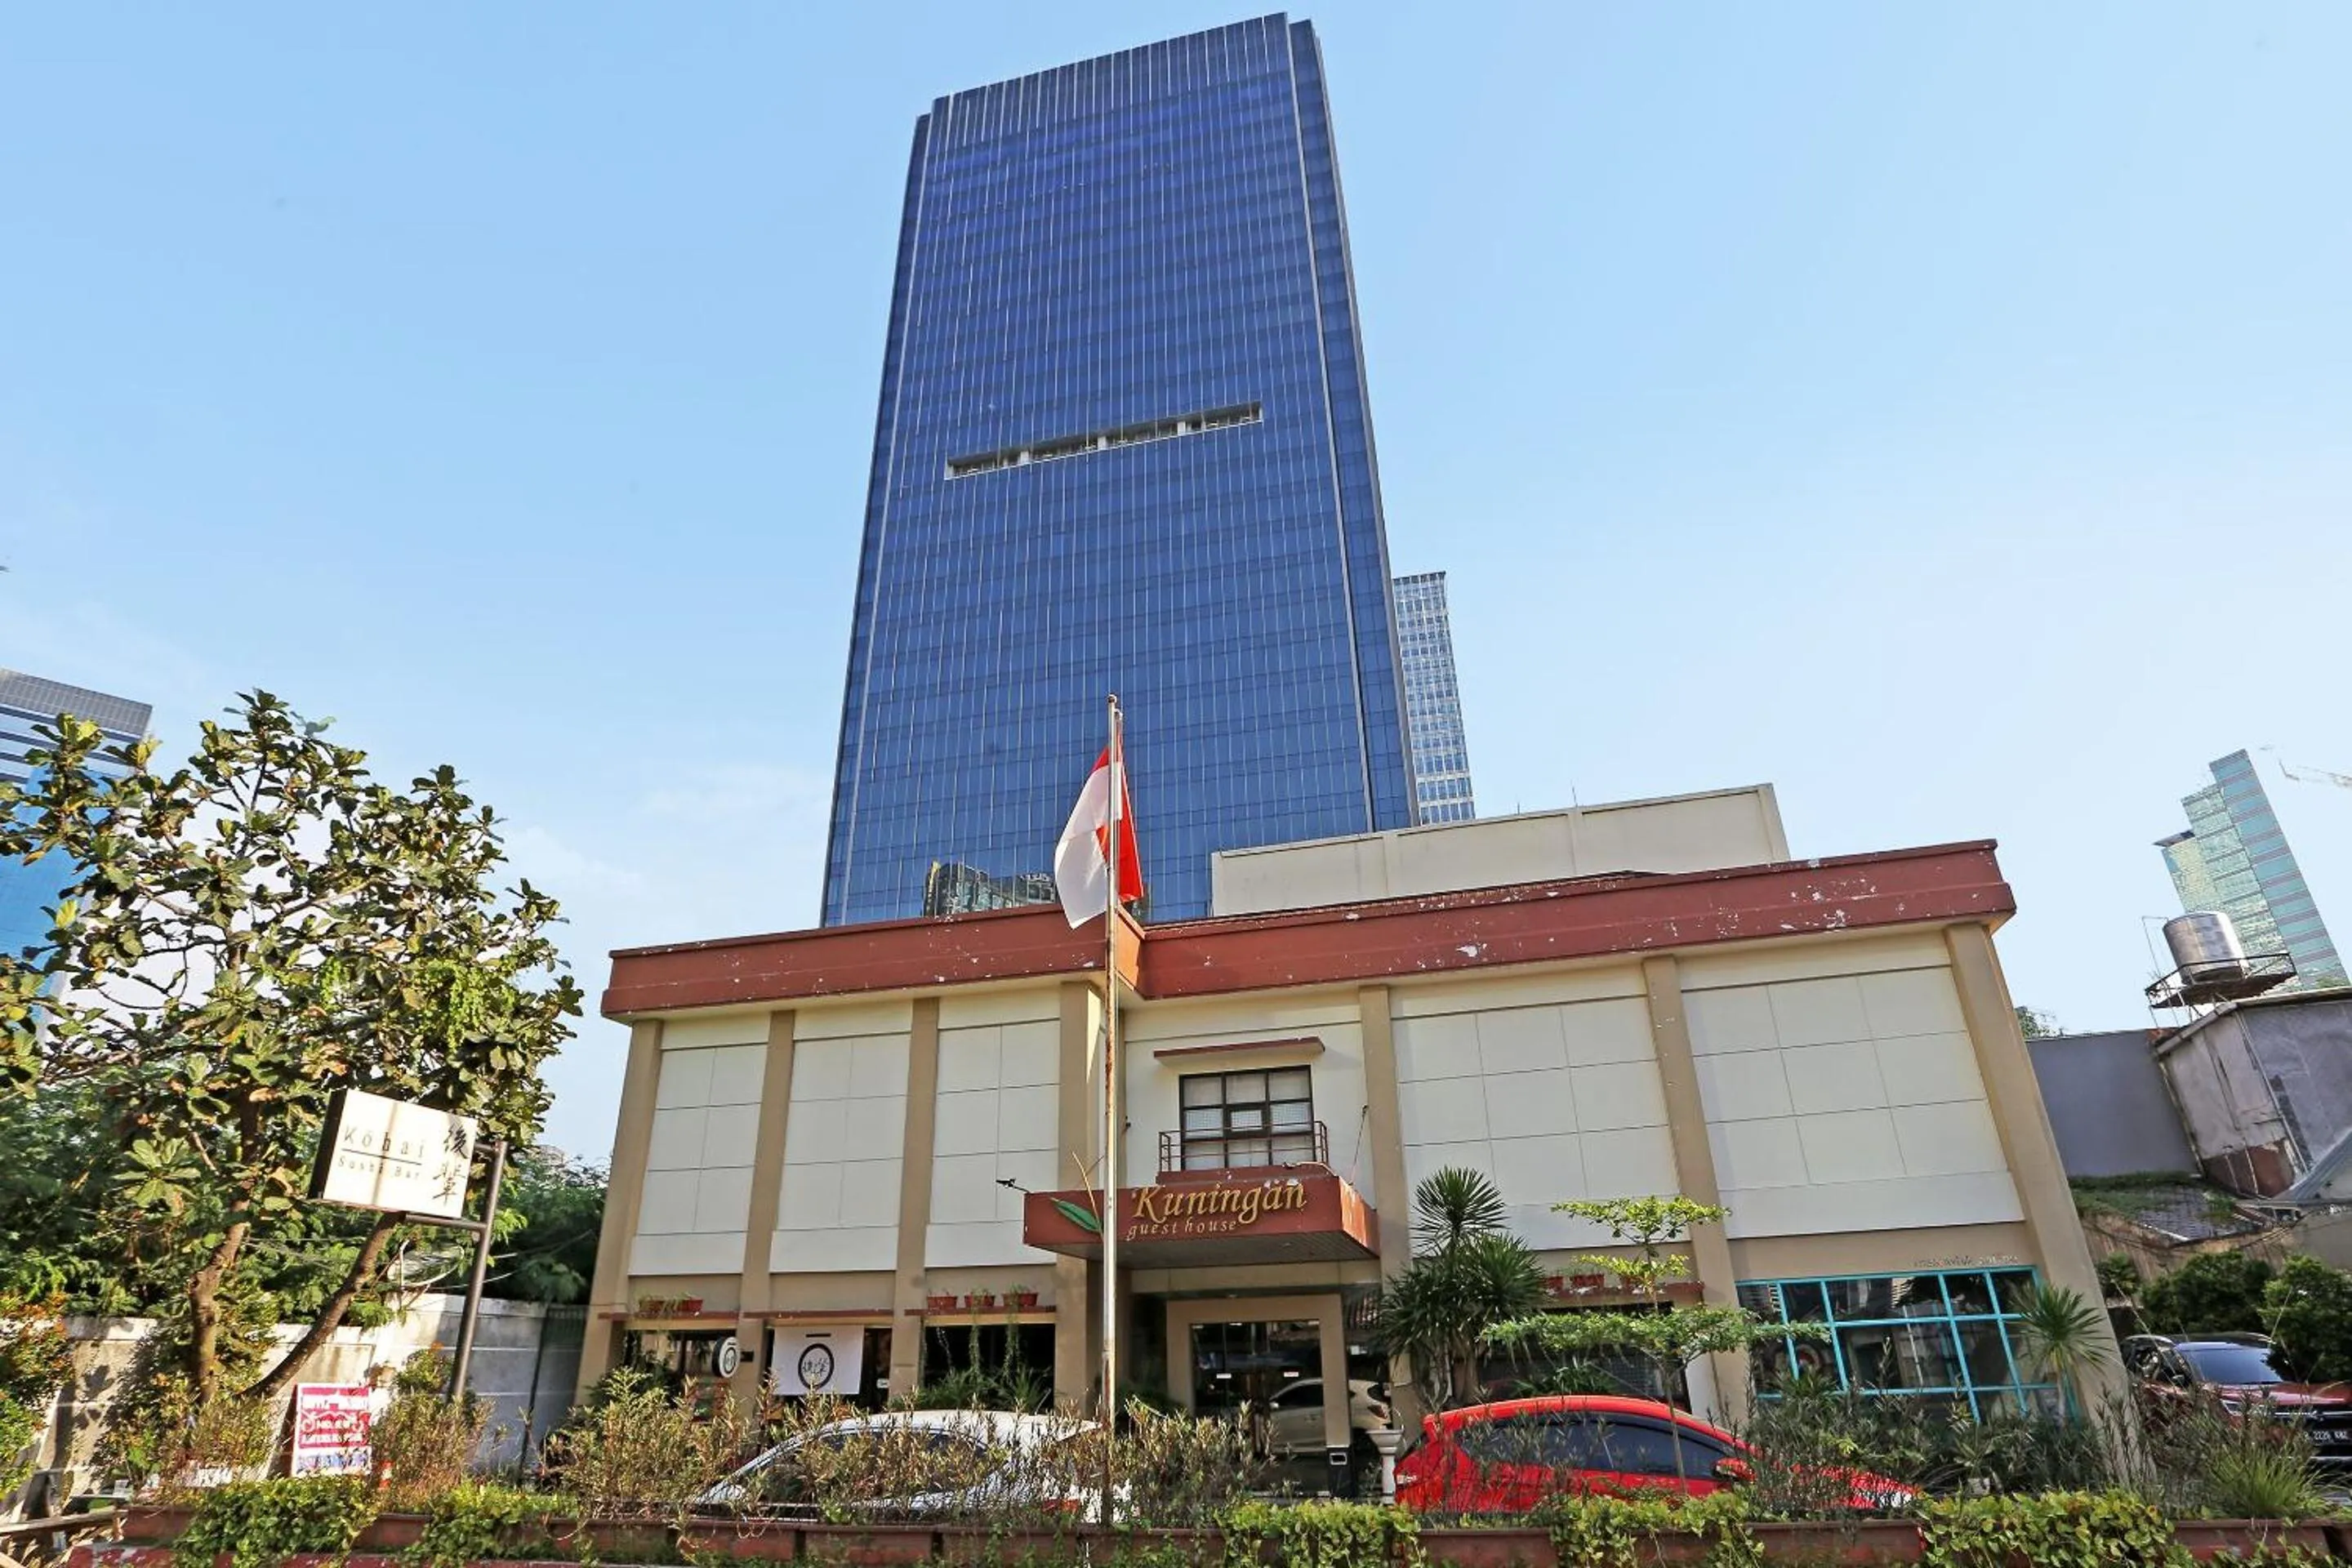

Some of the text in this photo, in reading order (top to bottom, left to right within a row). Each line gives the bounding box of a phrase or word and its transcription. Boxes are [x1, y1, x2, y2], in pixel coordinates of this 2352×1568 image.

[394, 1166, 420, 1180] Bar
[1132, 1181, 1307, 1223] Kuningan
[1126, 1216, 1237, 1241] guest house
